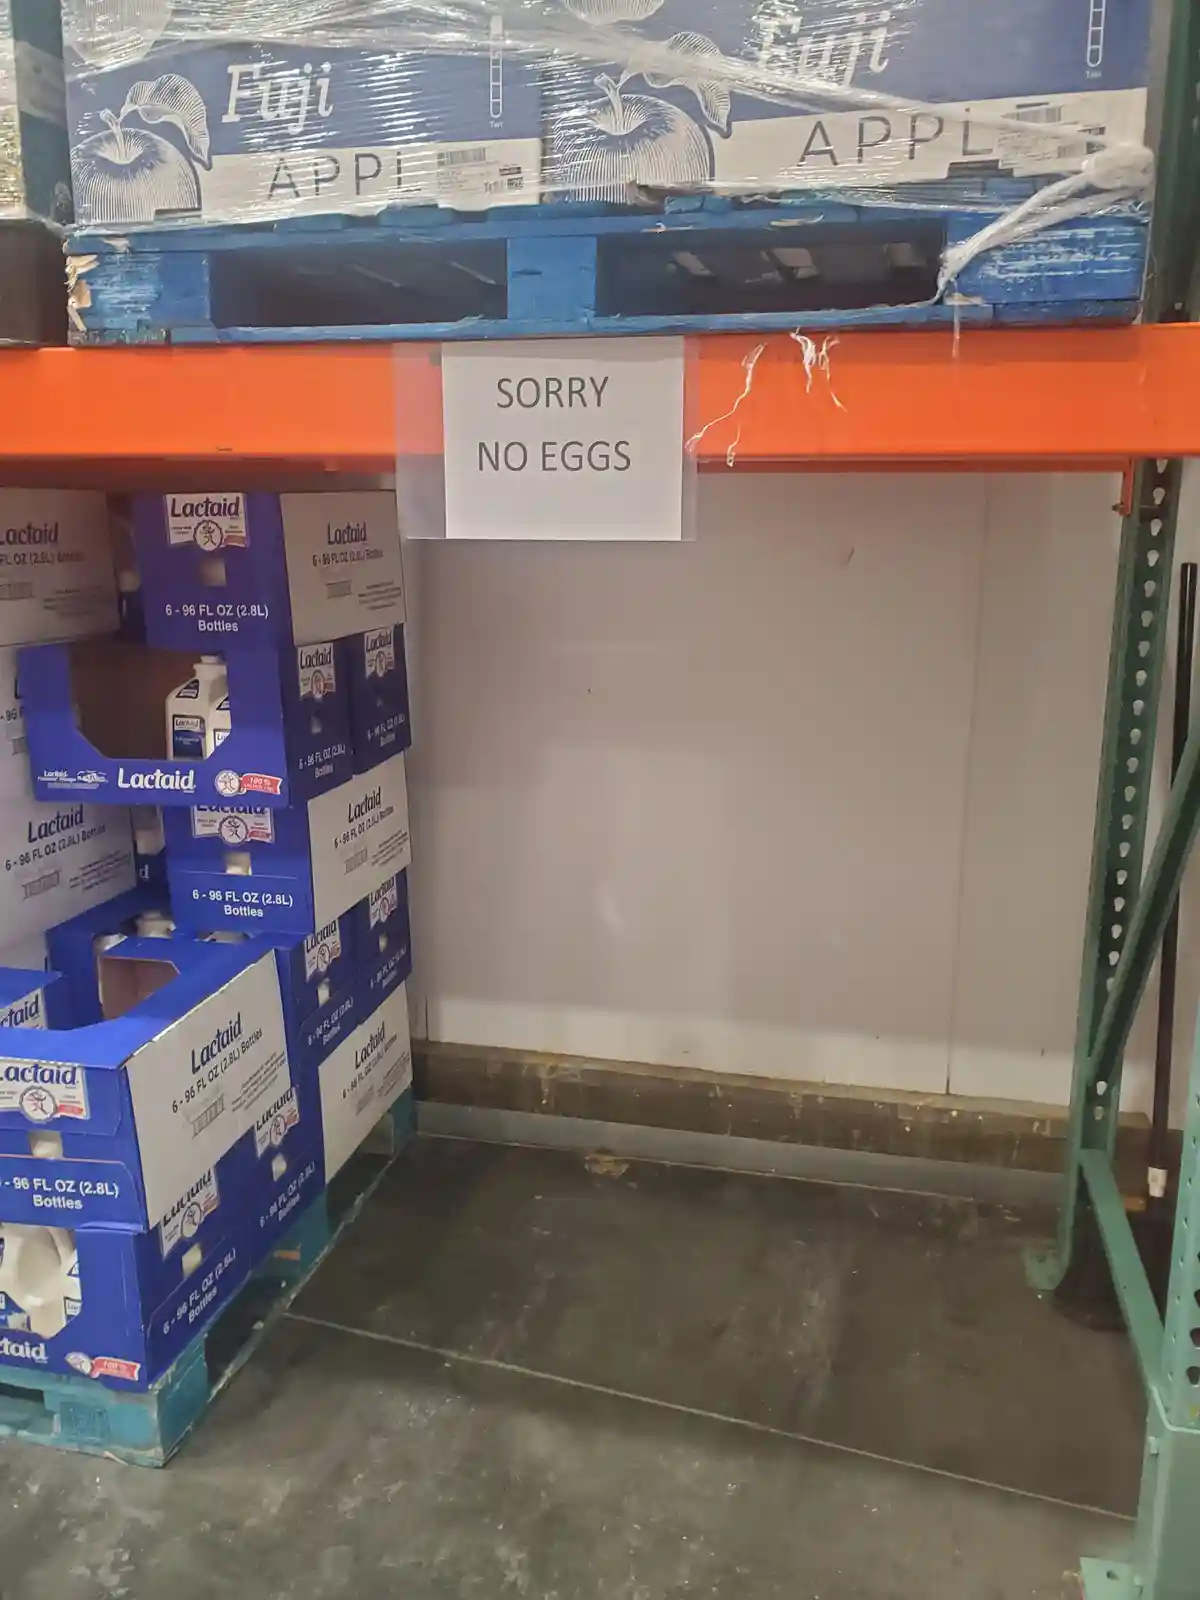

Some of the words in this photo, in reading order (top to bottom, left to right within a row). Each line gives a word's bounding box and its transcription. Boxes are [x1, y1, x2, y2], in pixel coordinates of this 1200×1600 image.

[221, 61, 334, 135] Fuji
[497, 376, 609, 409] SORRY
[478, 441, 528, 472] NO
[541, 440, 632, 472] EGGS
[170, 496, 240, 518] Lactaid
[328, 521, 367, 545] Lactaid
[165, 604, 172, 617] 6
[182, 604, 196, 617] 96
[199, 604, 214, 617] FL
[216, 604, 234, 617] OZ
[236, 604, 269, 619] (2.8L)
[198, 619, 239, 632] Bottles
[366, 630, 392, 652] Lactaid
[300, 648, 332, 669] Lactaid
[118, 767, 194, 790] Lactaid
[348, 786, 381, 823] Lactaid
[28, 803, 84, 843] Lactaid
[5, 860, 11, 871] 6
[19, 851, 31, 866] 96
[32, 847, 43, 861] FL
[44, 842, 57, 856] OZ
[192, 889, 199, 900] 6
[209, 890, 222, 902] 96
[225, 891, 240, 903] FL
[242, 891, 259, 904] OZ
[261, 893, 293, 907] (2.8L)
[224, 904, 264, 918] Bottles
[191, 1011, 243, 1075] Lactaid
[355, 1020, 386, 1070] Lactaid
[172, 1100, 178, 1114] 6
[184, 1088, 196, 1104] 96
[196, 1079, 208, 1094] FL
[208, 1063, 220, 1083] OZ
[220, 1048, 241, 1076] (2.8L)
[241, 1027, 264, 1055] Bottles
[13, 1176, 30, 1190] 96
[33, 1177, 52, 1192] FL
[55, 1180, 76, 1194] OZ
[79, 1182, 120, 1198] (2.8L)
[33, 1194, 83, 1210] Bottles
[163, 1320, 170, 1335] 6
[176, 1302, 189, 1319] 96
[189, 1291, 201, 1307] FL
[201, 1271, 214, 1292] OZ
[188, 1286, 219, 1325] Bottles
